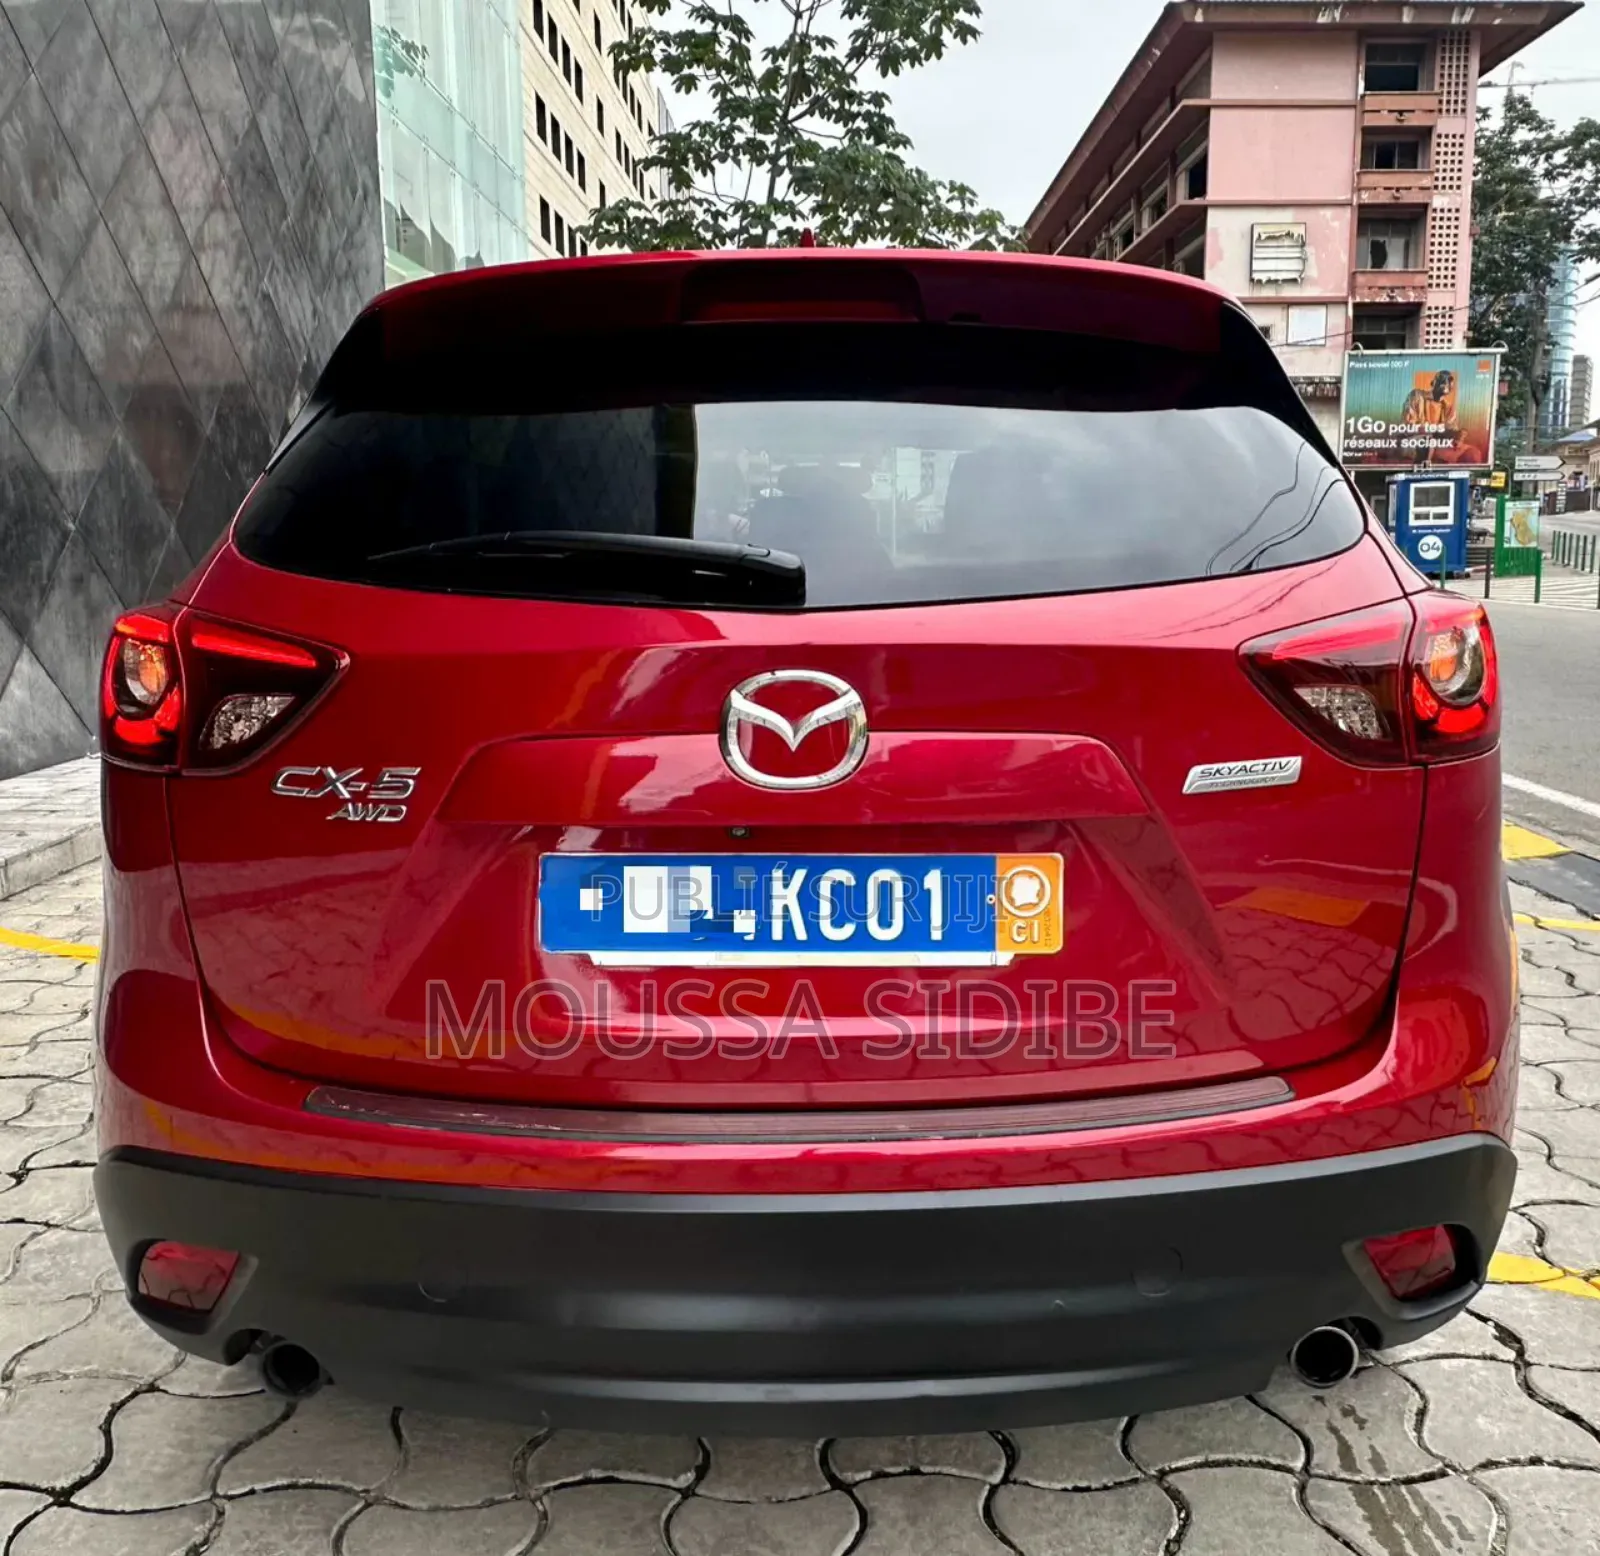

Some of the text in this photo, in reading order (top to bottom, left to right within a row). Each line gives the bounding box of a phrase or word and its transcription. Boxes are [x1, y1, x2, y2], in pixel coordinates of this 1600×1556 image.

[1346, 416, 1445, 435] 1Go pour tes
[1344, 435, 1454, 448] réseaux sociaux
[1420, 541, 1440, 552] 04
[1199, 760, 1291, 777] SKYACTIV
[271, 766, 422, 799] CX-5
[325, 802, 407, 822] AWD
[1011, 919, 1041, 944] CI
